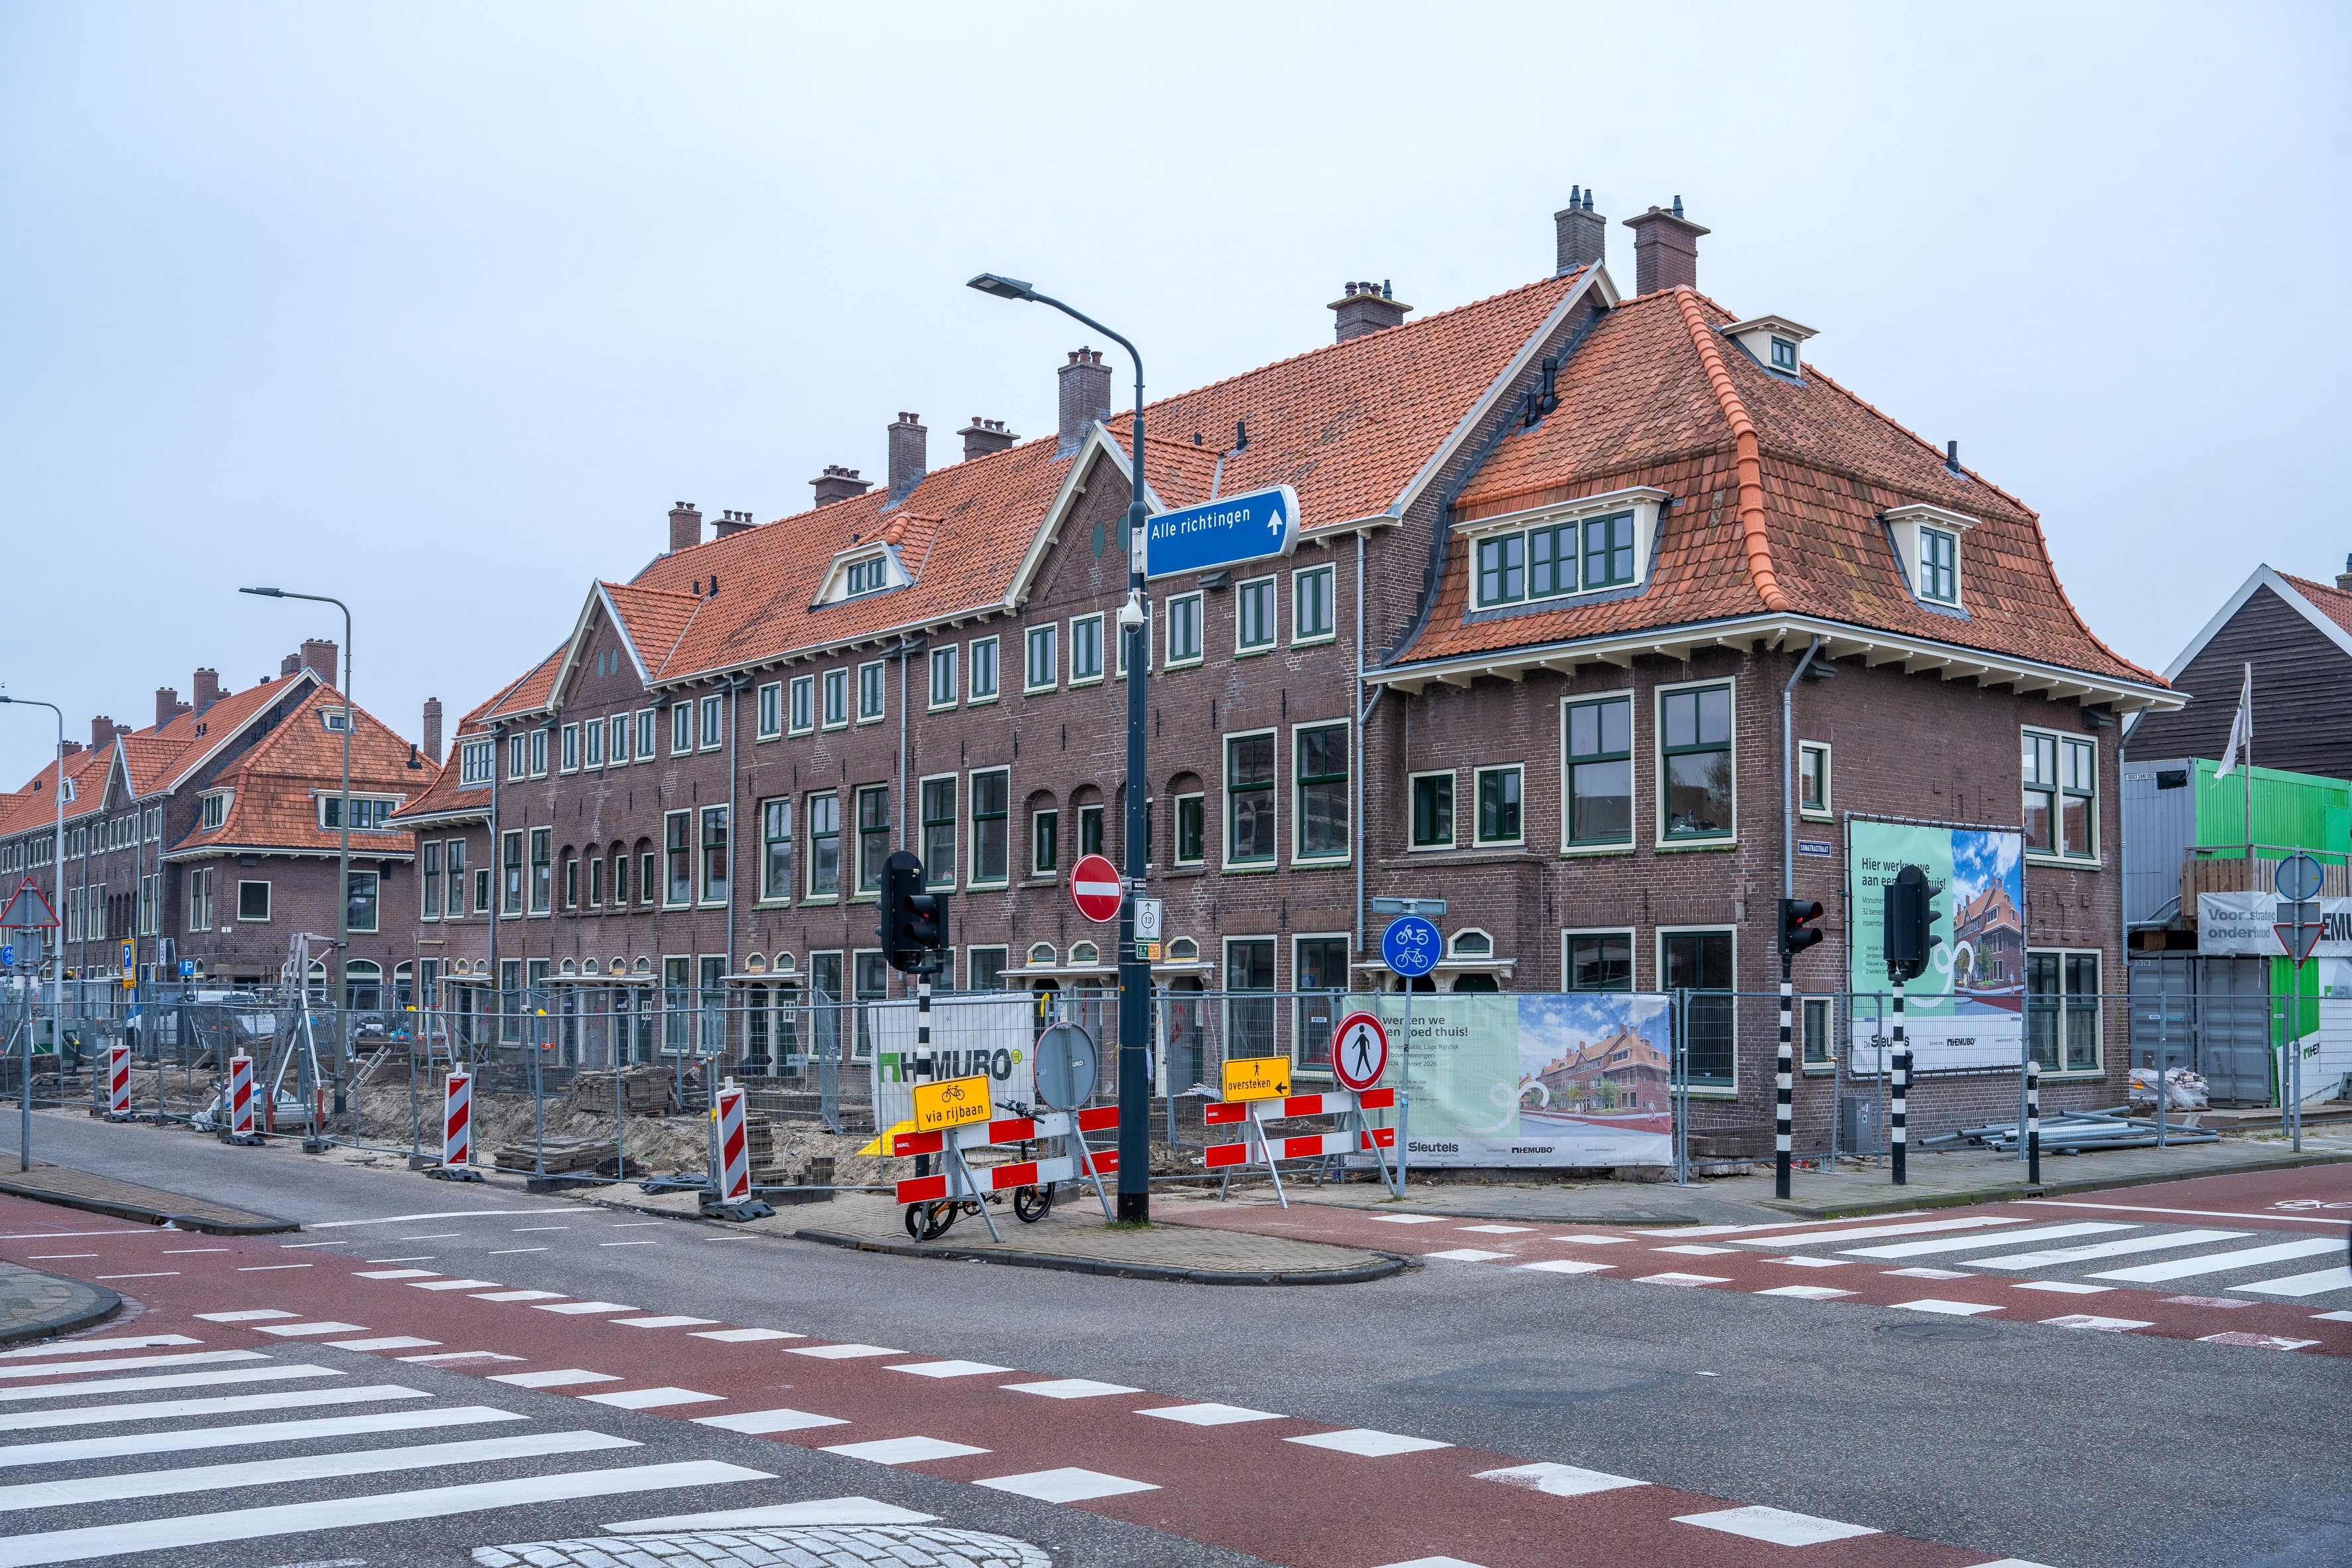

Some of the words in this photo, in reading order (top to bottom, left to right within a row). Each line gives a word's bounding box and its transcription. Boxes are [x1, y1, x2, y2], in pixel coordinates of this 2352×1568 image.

[1152, 521, 1176, 540] Alle
[1181, 509, 1250, 534] richtingen
[1800, 844, 1829, 853] SUMATRASTRAAT
[1861, 857, 1881, 871] Hier
[1883, 859, 1915, 872] werk
[1862, 876, 1878, 886] aan
[1927, 877, 1946, 890] huis!
[2208, 908, 2245, 921] Voor
[2250, 908, 2276, 924] strateg
[2208, 925, 2270, 939] onderhoud
[124, 947, 130, 965] P
[185, 961, 193, 972] P
[1409, 1027, 1432, 1038] oed
[1435, 1027, 1468, 1036] thuis!
[900, 1048, 1012, 1083] HMUBO
[1228, 1079, 1271, 1091] oversteken
[925, 1110, 943, 1123] via
[946, 1103, 984, 1124] rijbaan
[1407, 1141, 1459, 1152] Sleutels
